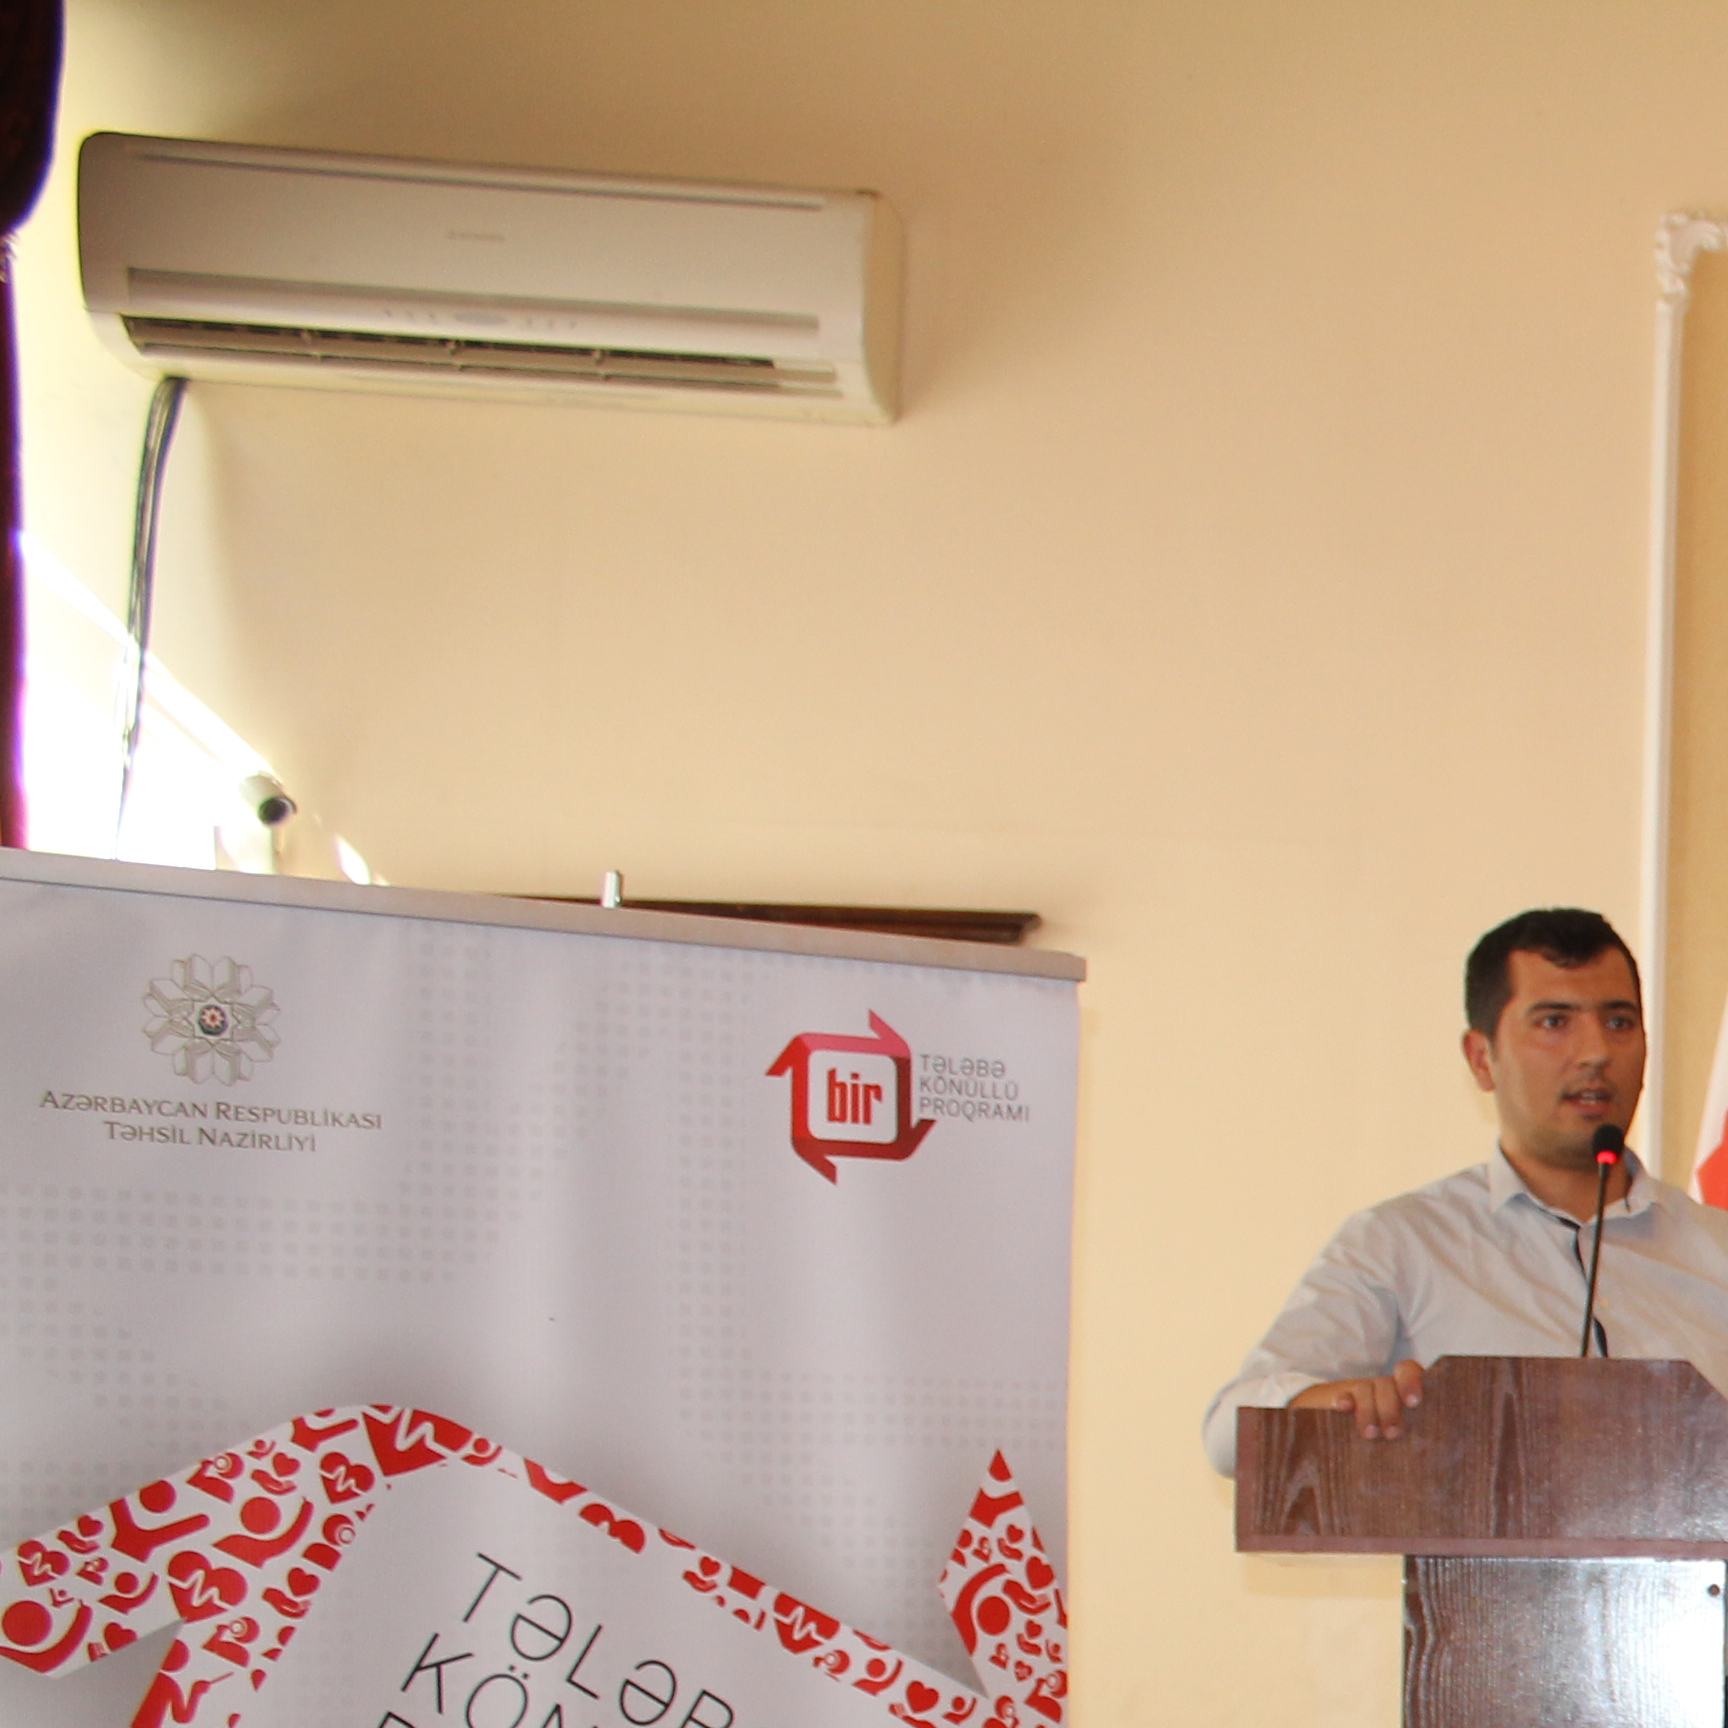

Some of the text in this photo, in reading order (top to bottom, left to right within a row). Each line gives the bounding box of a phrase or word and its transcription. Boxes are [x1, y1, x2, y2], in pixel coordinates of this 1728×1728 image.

[919, 1053, 1006, 1079] TƏLƏBƏ
[38, 1090, 383, 1131] AZƏRBAYCAN RESPUBLİKASI
[827, 1067, 883, 1125] bir
[918, 1097, 1030, 1123] PROQRAMI
[103, 1121, 317, 1153] TƏHSİL NAZİRLİYİ
